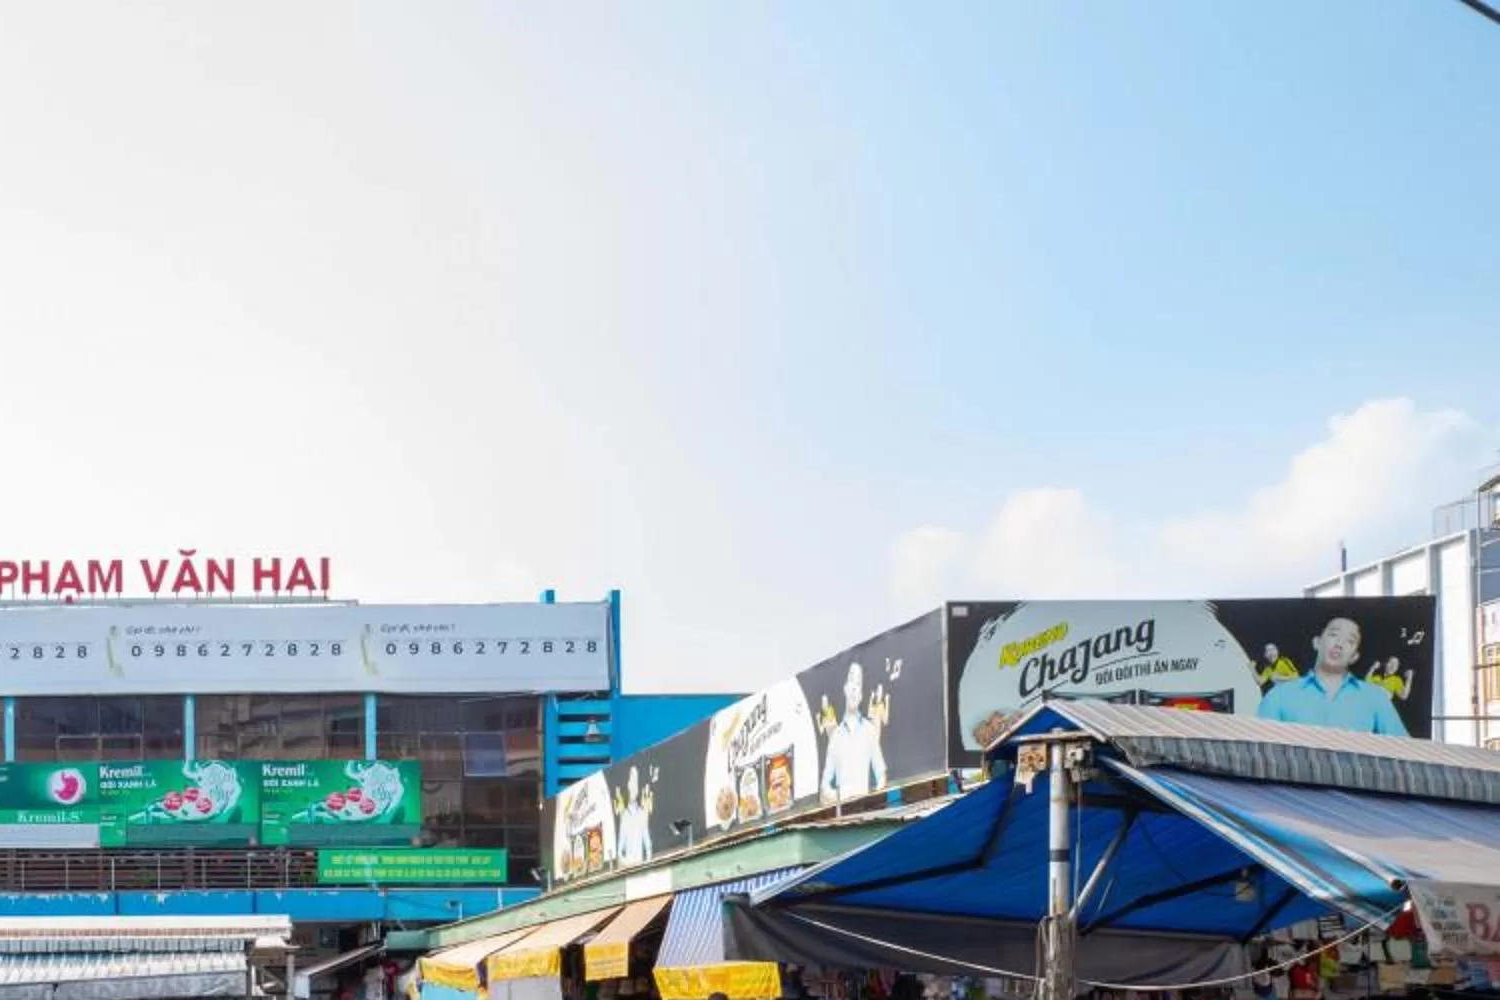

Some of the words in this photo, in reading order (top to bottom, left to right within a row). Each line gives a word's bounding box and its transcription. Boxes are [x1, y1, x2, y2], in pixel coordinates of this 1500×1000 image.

[139, 548, 236, 593] VĂN
[252, 556, 331, 592] HAI
[1018, 618, 1156, 698] Chajang
[262, 763, 305, 777] Kremil
